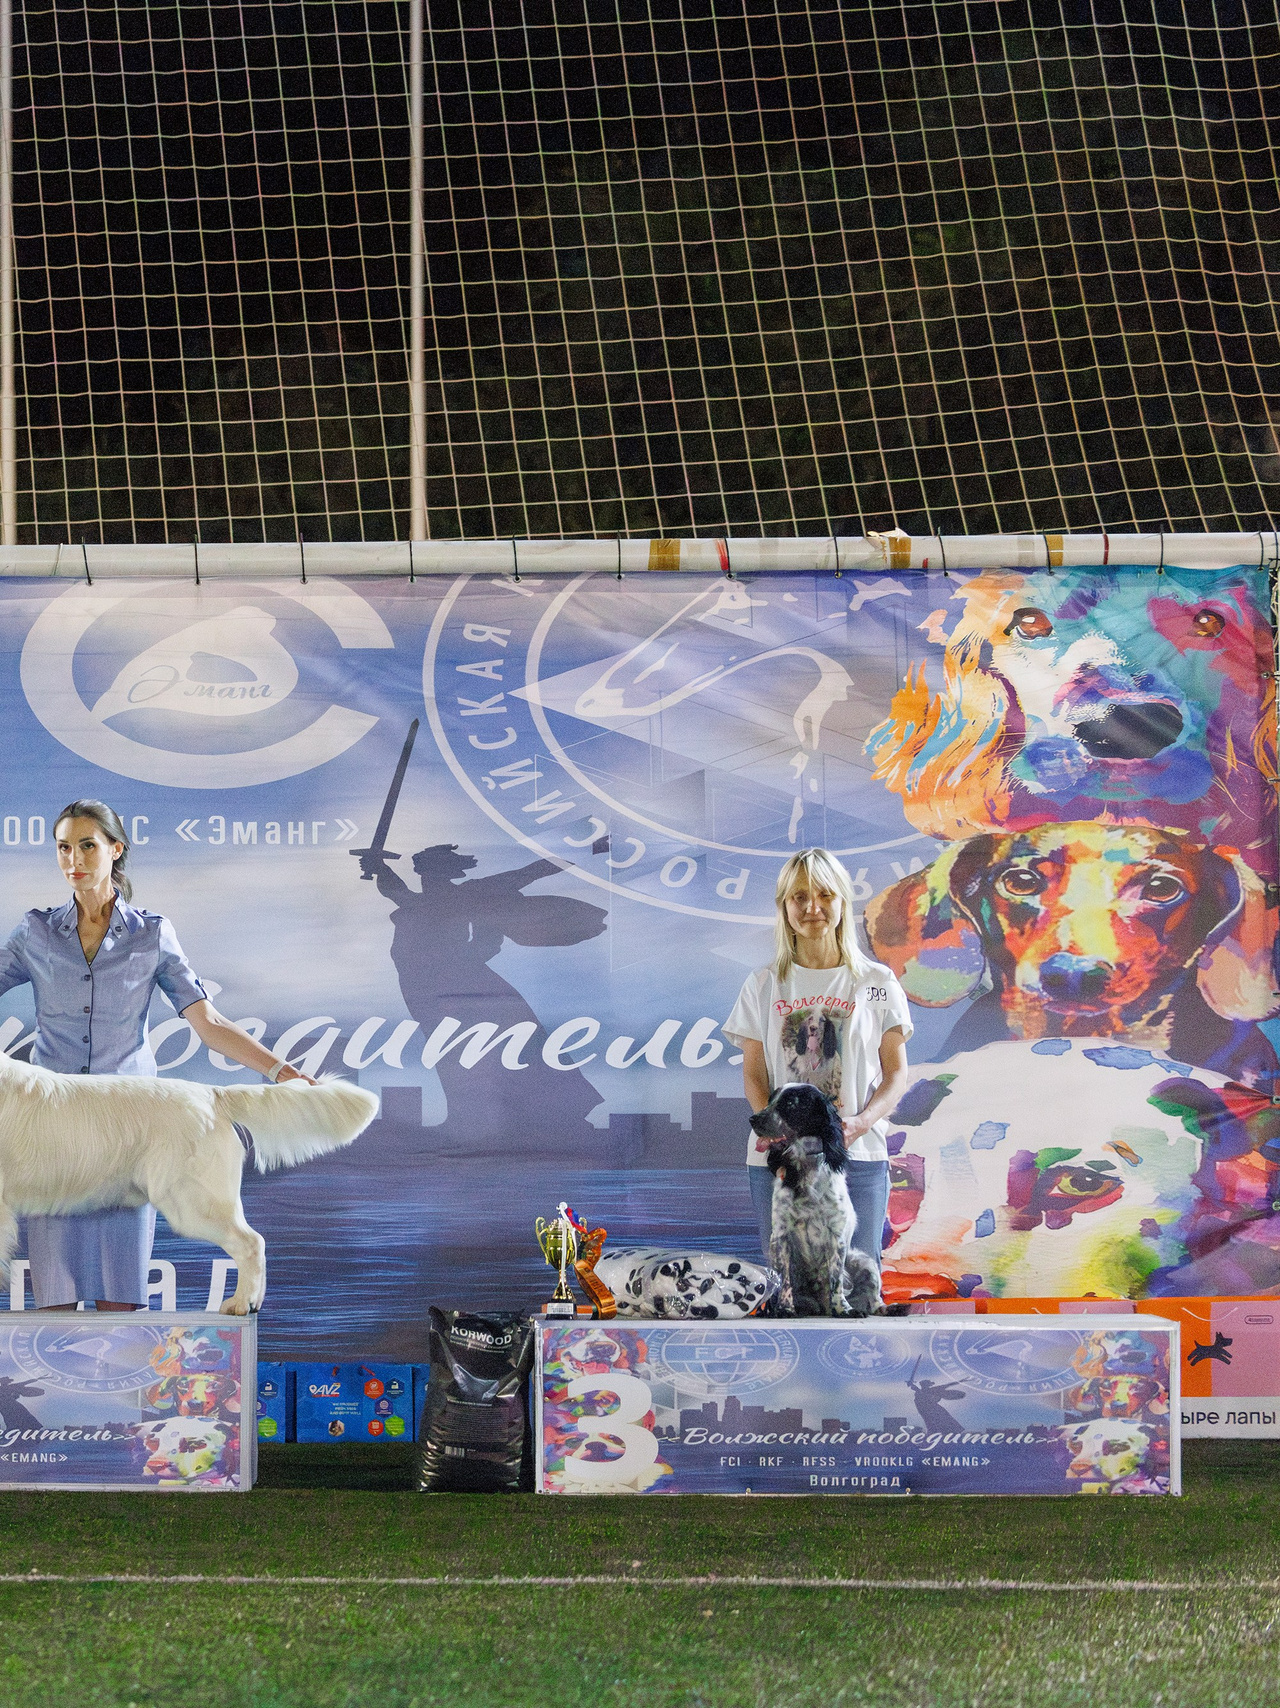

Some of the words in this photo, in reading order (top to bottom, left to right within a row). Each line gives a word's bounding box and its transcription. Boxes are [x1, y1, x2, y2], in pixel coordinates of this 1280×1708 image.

[175, 815, 360, 845] «Эманг»
[451, 1325, 512, 1347] KORWOOD
[315, 1382, 341, 1395] AVZ
[1224, 1411, 1276, 1425] лапы
[565, 1373, 659, 1478] 3
[0, 1452, 69, 1463] «EMANG»
[720, 1456, 741, 1467] FCI
[759, 1456, 784, 1467] RKF
[803, 1457, 837, 1467] RFSS
[855, 1457, 914, 1467] VROOKLG
[921, 1457, 991, 1468] «EMANG»
[810, 1474, 901, 1489] Волгоград
